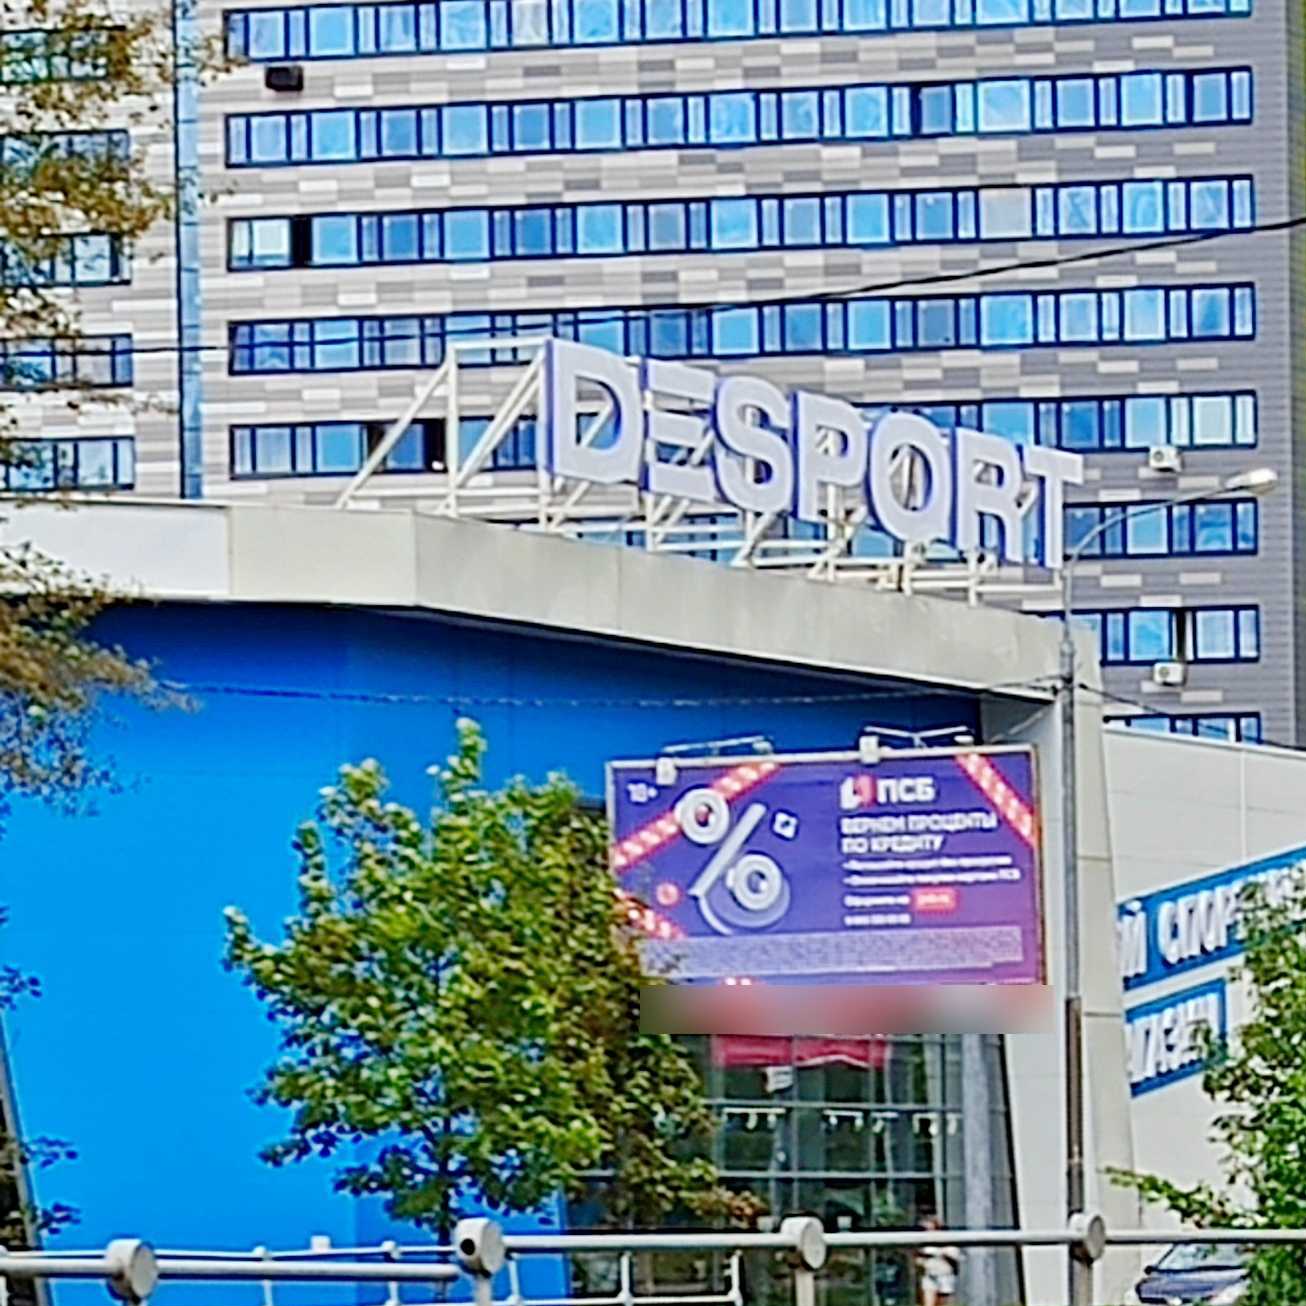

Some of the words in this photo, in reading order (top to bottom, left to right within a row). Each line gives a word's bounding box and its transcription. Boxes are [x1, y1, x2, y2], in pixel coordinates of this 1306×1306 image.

[545, 338, 1083, 568] DESPORT
[876, 777, 935, 804] ПСБ
[908, 811, 998, 832] ПРОЦЕНТЫ
[842, 837, 868, 853] ПО
[871, 834, 944, 852] КРЕДИТУ
